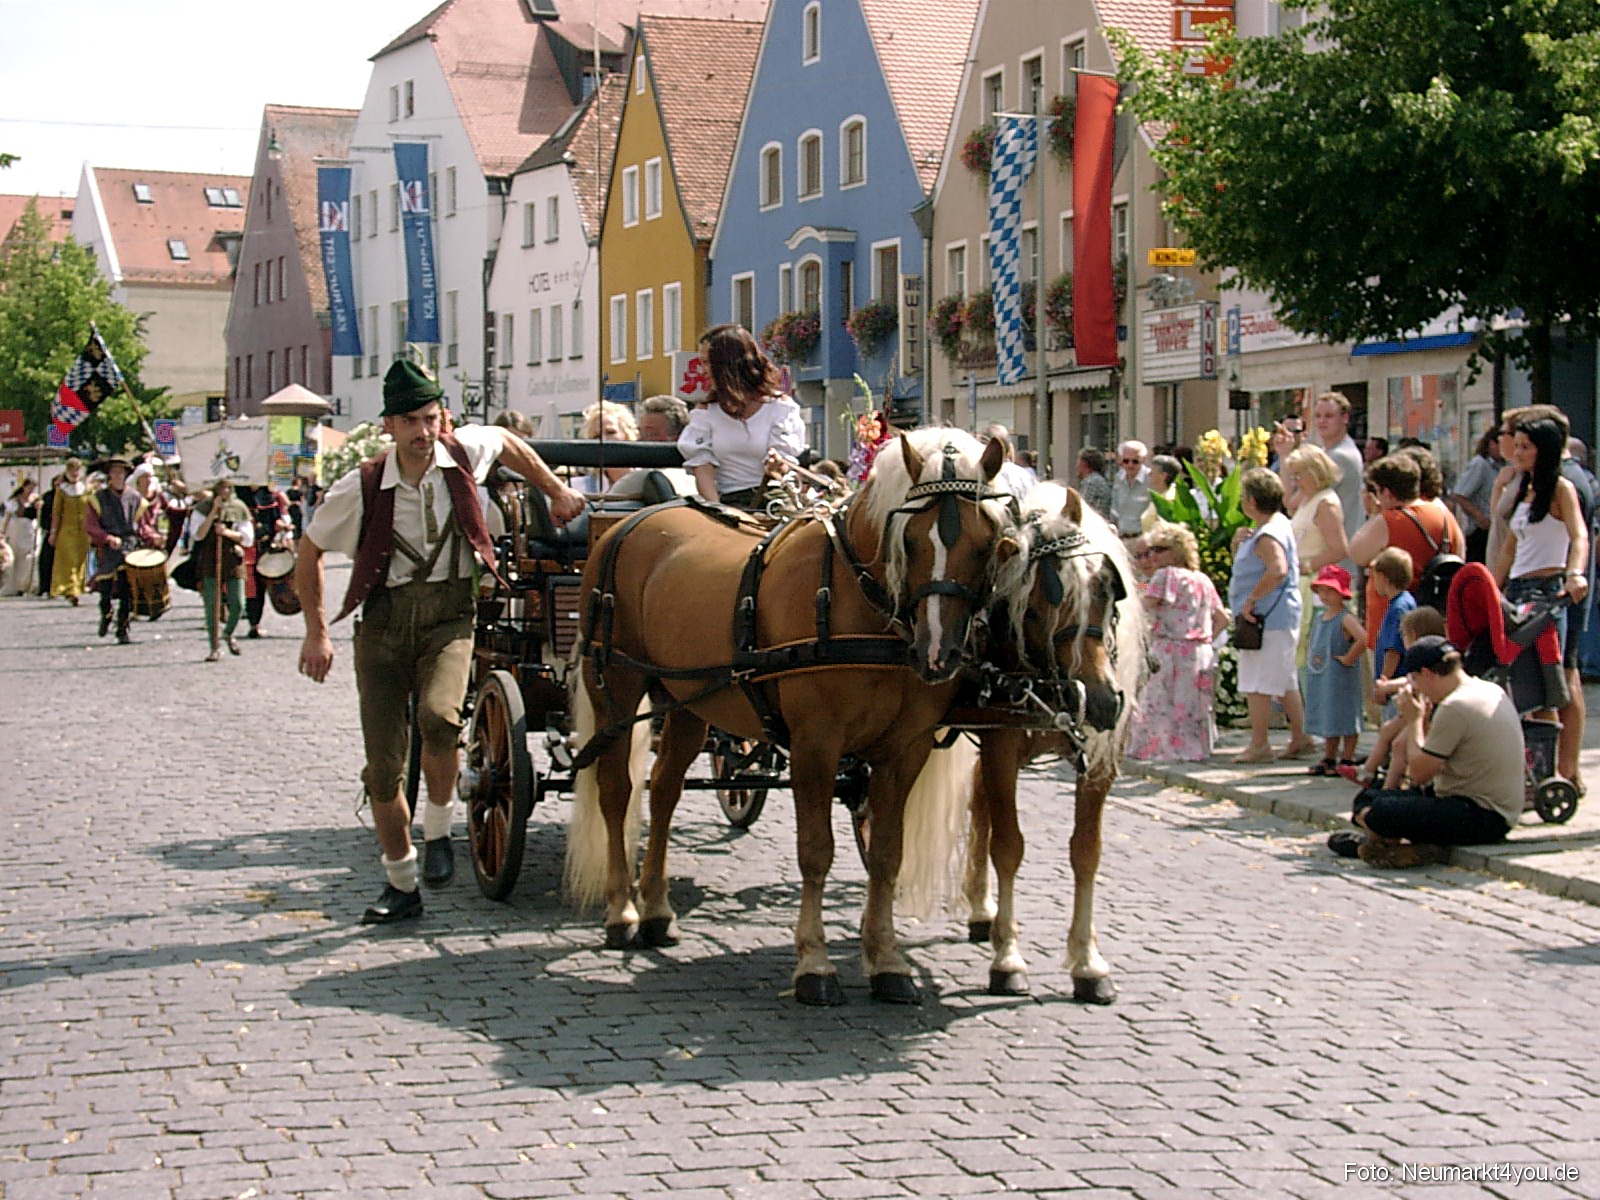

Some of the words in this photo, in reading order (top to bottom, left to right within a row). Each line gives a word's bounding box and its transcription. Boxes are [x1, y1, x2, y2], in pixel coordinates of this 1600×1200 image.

[528, 272, 551, 294] HOTEL
[905, 295, 919, 369] WITTL
[1204, 306, 1213, 373] KINO
